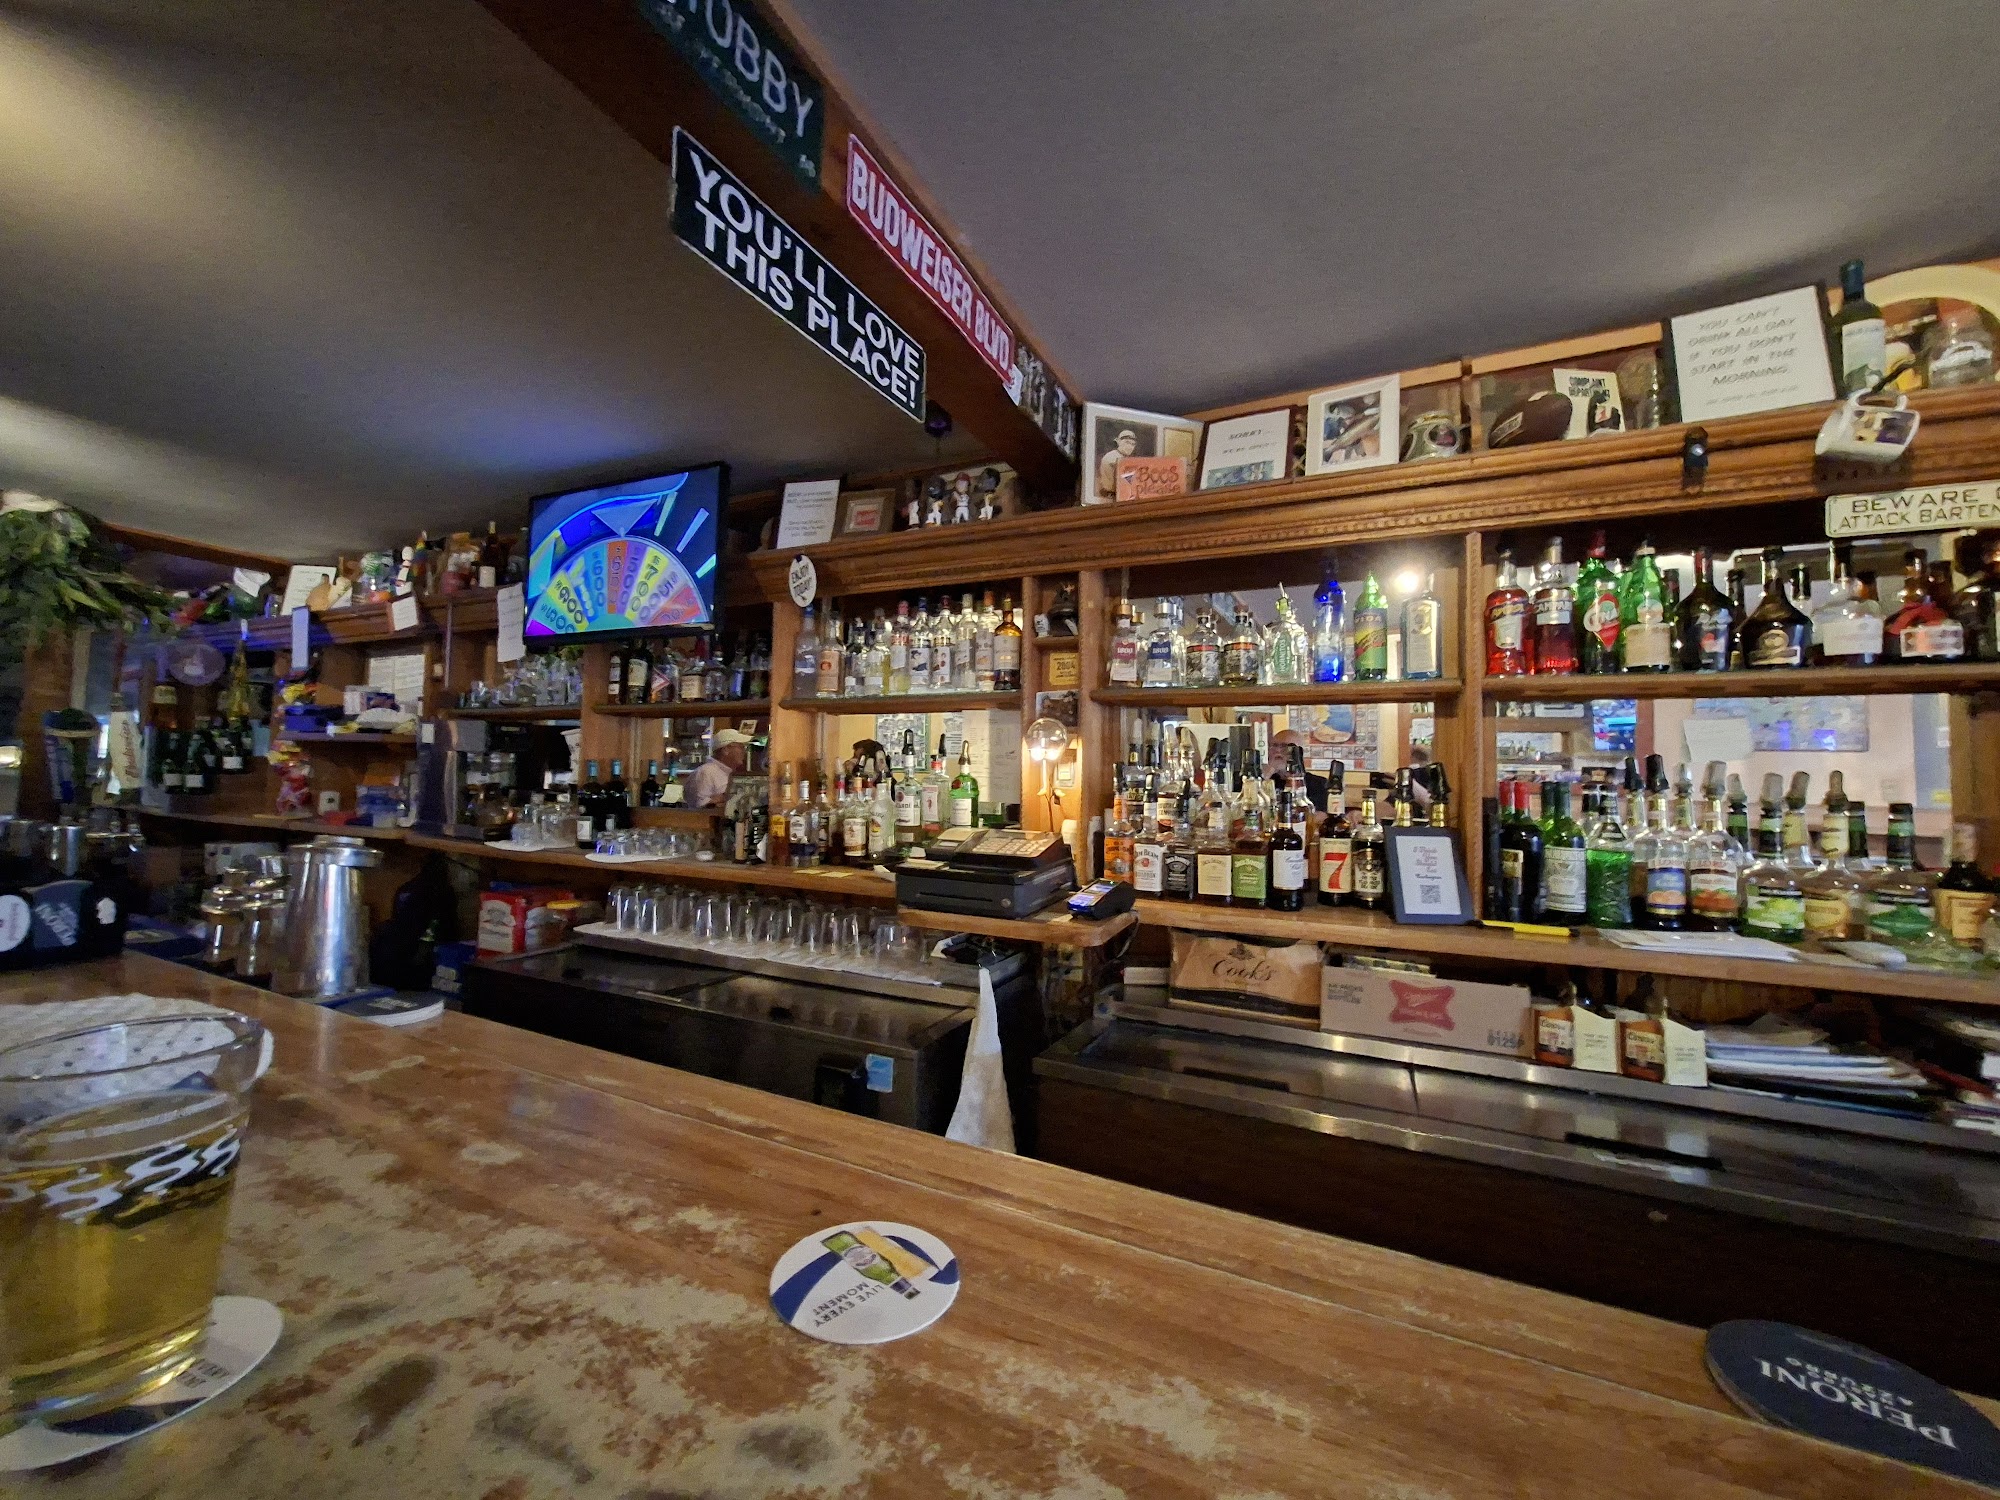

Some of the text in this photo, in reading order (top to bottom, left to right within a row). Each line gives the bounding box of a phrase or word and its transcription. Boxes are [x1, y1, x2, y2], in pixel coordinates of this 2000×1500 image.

[688, 0, 814, 138] OBBY
[852, 150, 972, 329] BUDWEISER
[690, 149, 921, 381] YOU'LL LOVE
[695, 201, 794, 312] THIS
[807, 295, 917, 409] PLACE!
[1765, 317, 1797, 333] DAY
[1839, 511, 1911, 530] ATTACK
[1852, 488, 1979, 513] BEWARE
[1323, 852, 1349, 890] 7
[1211, 958, 1276, 983] Cook's
[812, 1281, 869, 1316] MOMENT
[814, 1283, 885, 1328] LIVE EVERY
[1753, 1356, 1957, 1449] PERONI
